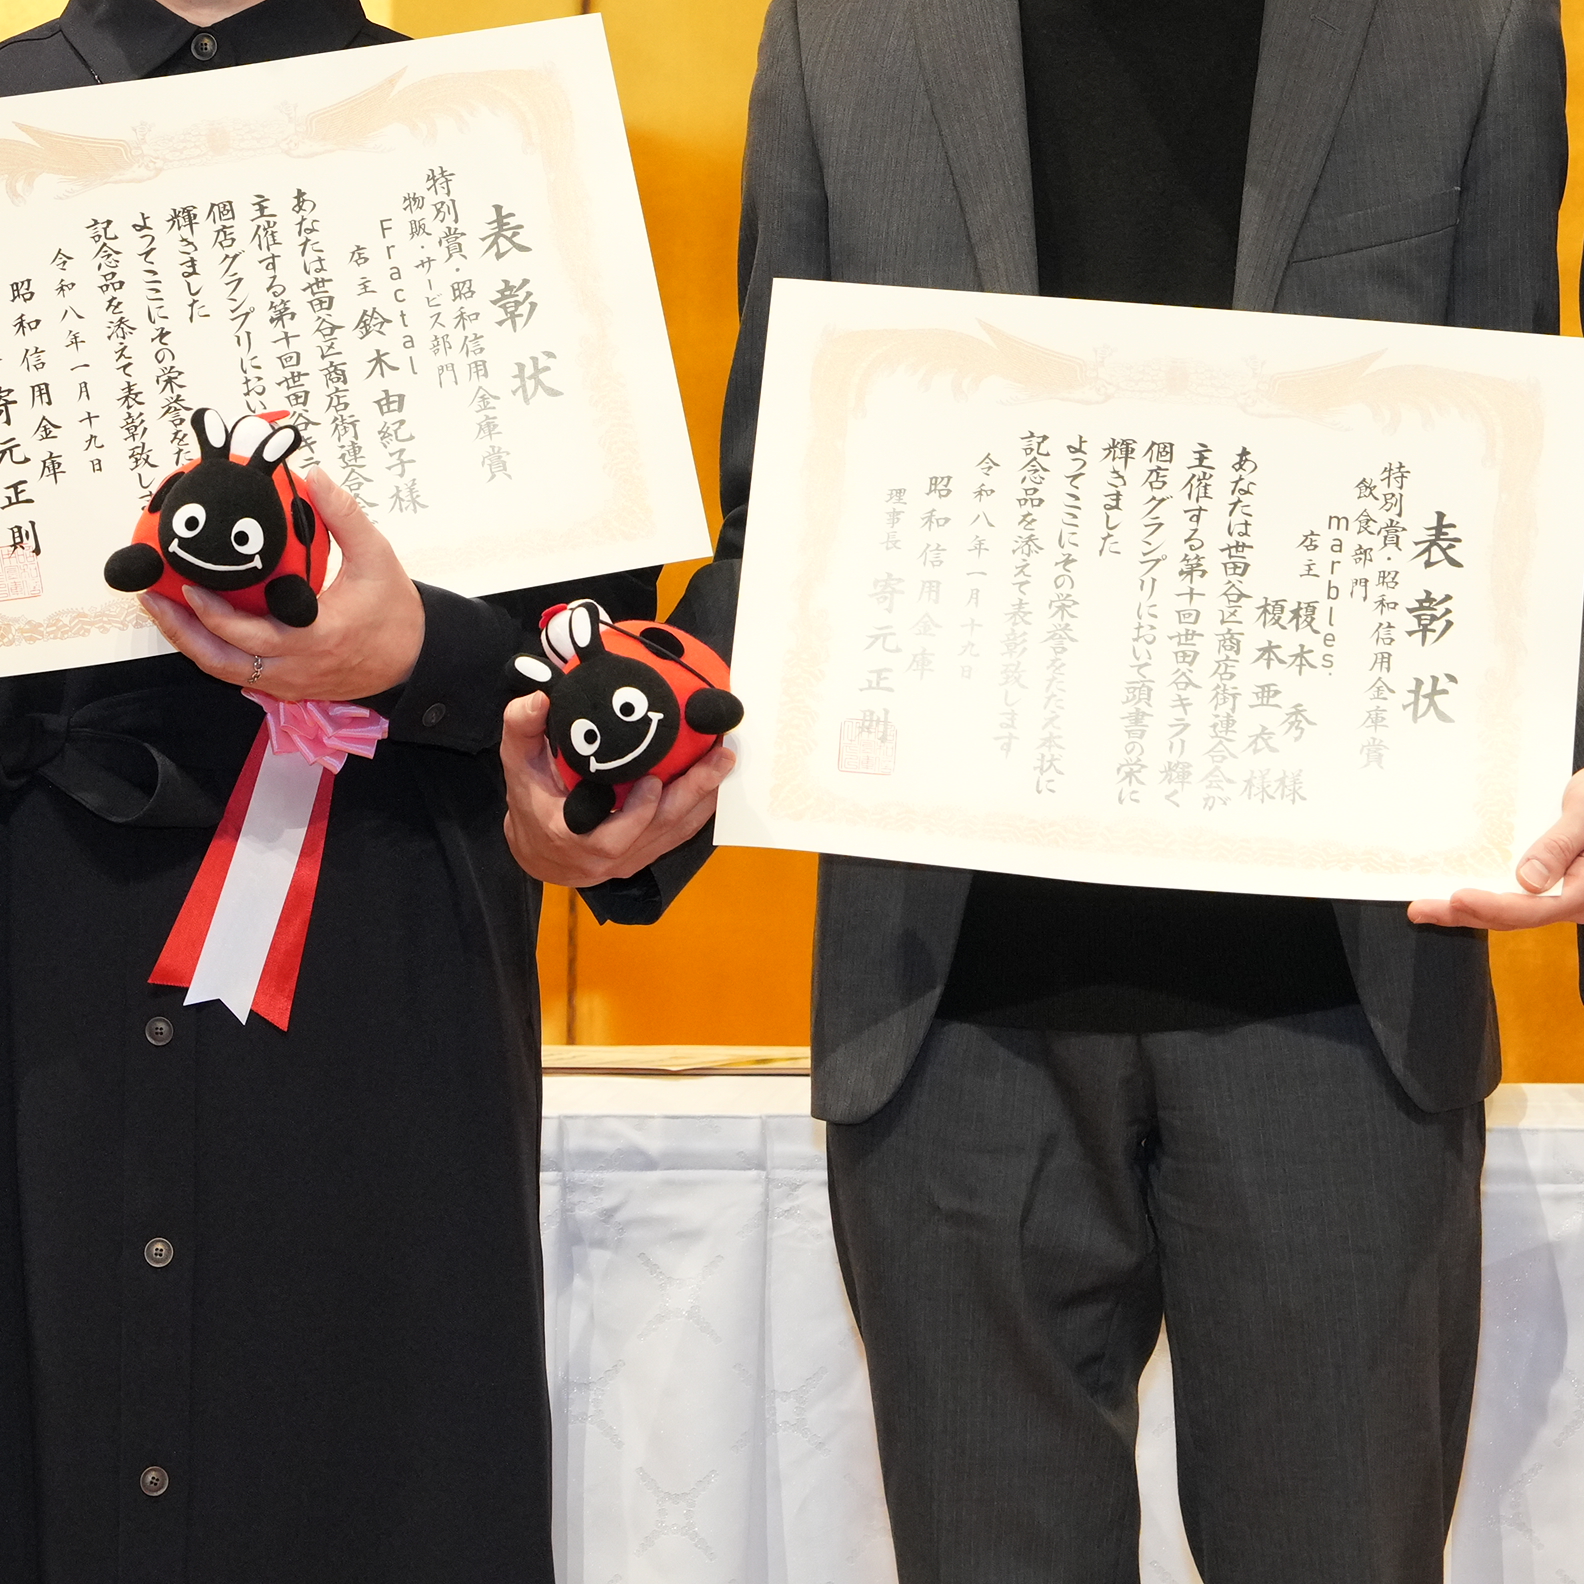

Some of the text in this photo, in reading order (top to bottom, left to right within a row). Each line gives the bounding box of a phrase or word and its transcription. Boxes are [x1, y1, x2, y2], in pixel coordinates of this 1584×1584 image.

[49, 247, 105, 474] 令和八年一月十九日
[131, 212, 194, 466] よってここにその栄誉をた
[165, 205, 211, 324] 輝きました
[291, 188, 380, 524] あなたは世田谷区商店街連合
[380, 218, 418, 376] Fractal
[402, 192, 459, 389] 物販・サービス部門
[425, 166, 513, 484] 特別賞・昭和信用金庫賞
[479, 203, 565, 406] 表彰状
[9, 278, 67, 485] 昭和信用金庫
[347, 244, 429, 514] 店主 鈴木由紀子様
[879, 487, 908, 551] 理事長
[905, 475, 953, 681] 昭和信用金庫
[957, 452, 1001, 680] 令和八年一月十九日
[993, 430, 1051, 759] 記念品を添えて表彰致します
[1099, 437, 1138, 557] 輝きました
[1296, 529, 1321, 578] 店主
[1349, 477, 1380, 603] 飲食部門
[856, 571, 906, 744] 寄元正則
[1033, 434, 1088, 795] よってここにその栄誉をたたえ本状に
[1116, 440, 1175, 805] 個店グランプリにおいて頭書の栄に
[1158, 442, 1216, 808] 主催する第十回世田谷キラリ輝く
[1197, 446, 1258, 811] あなたは世田谷区商店街連合会が
[1239, 597, 1288, 804] 榎本亜衣様
[1359, 461, 1411, 770] 特別賞・昭和信用金庫賞
[1402, 511, 1465, 724] 表彰状
